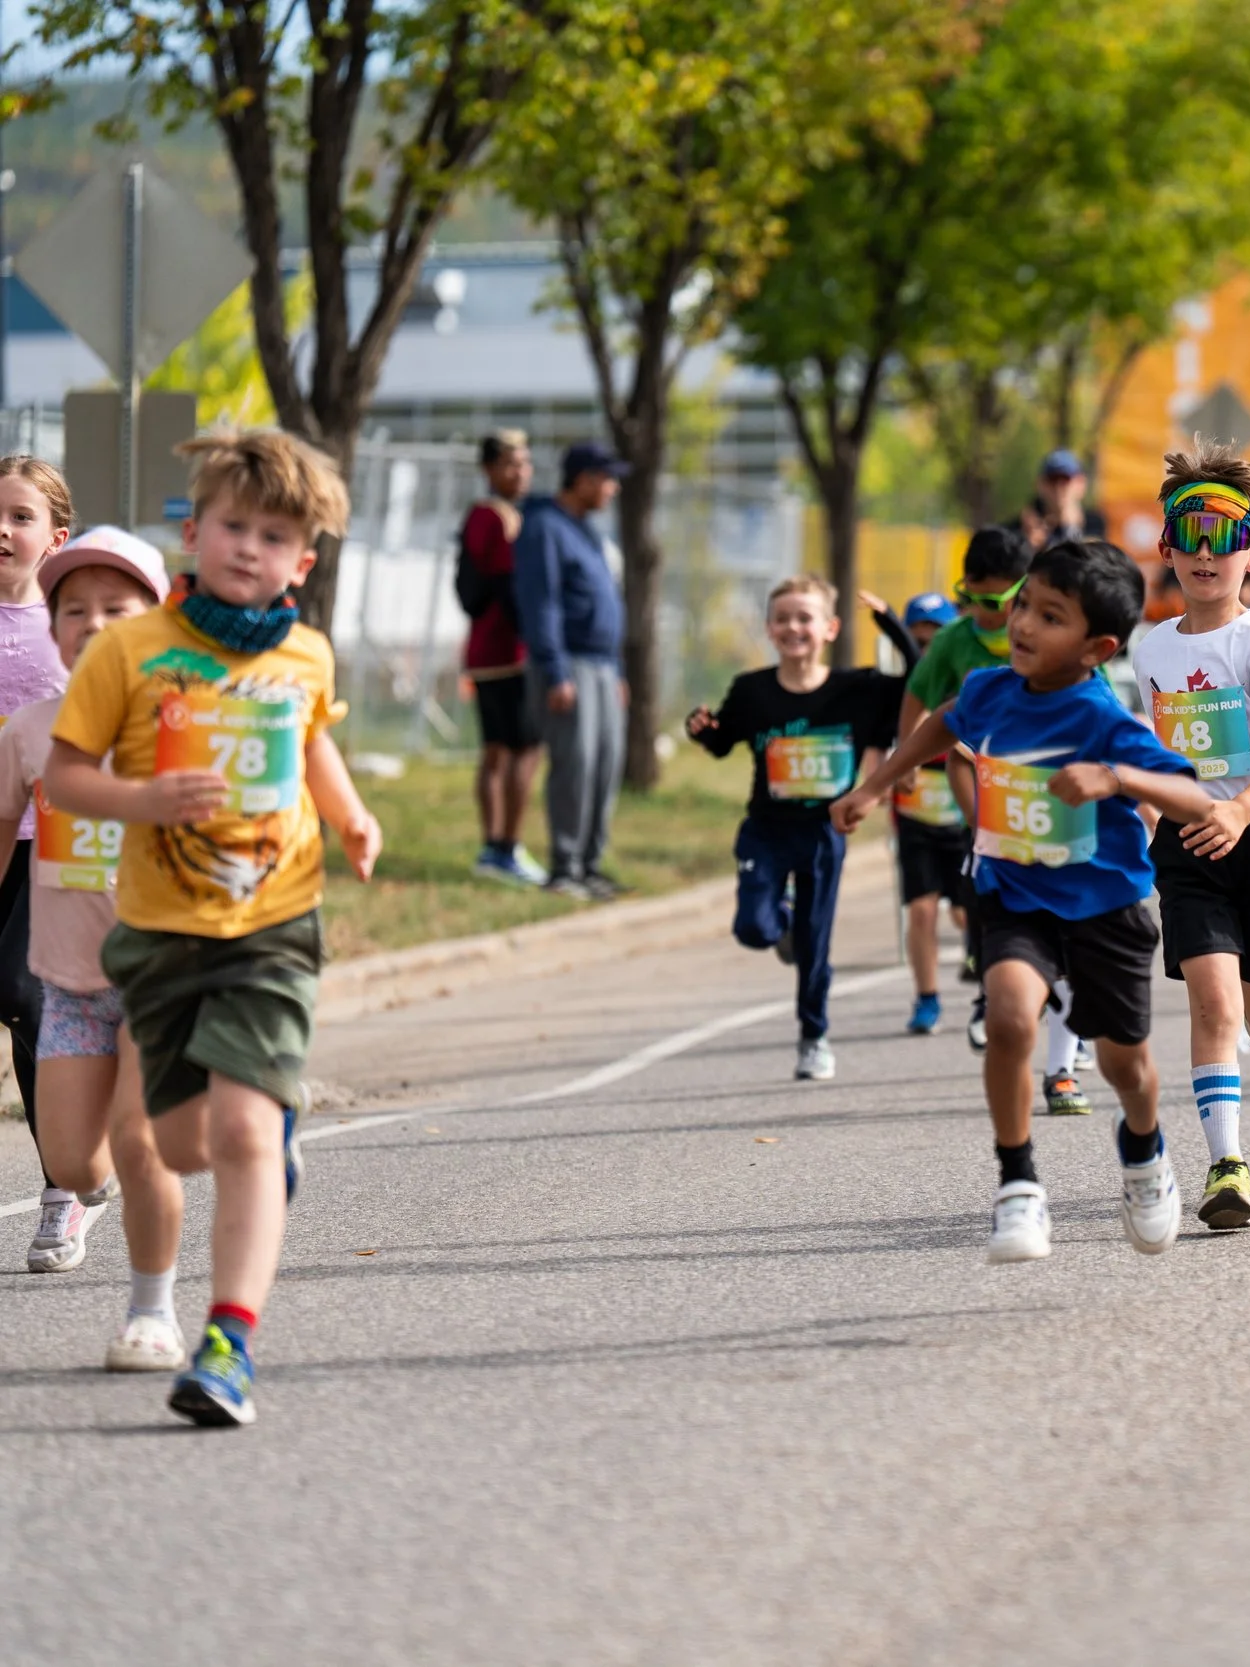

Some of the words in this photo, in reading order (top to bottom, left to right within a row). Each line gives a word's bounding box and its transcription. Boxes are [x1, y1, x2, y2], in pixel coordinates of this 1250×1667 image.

[1198, 703, 1219, 713] FUN
[1220, 699, 1242, 710] RUN
[1171, 720, 1212, 752] 48
[207, 733, 267, 779] 78
[788, 755, 833, 779] 101
[1200, 763, 1226, 774] 2025
[1005, 796, 1053, 836] 56
[71, 818, 126, 858] 29
